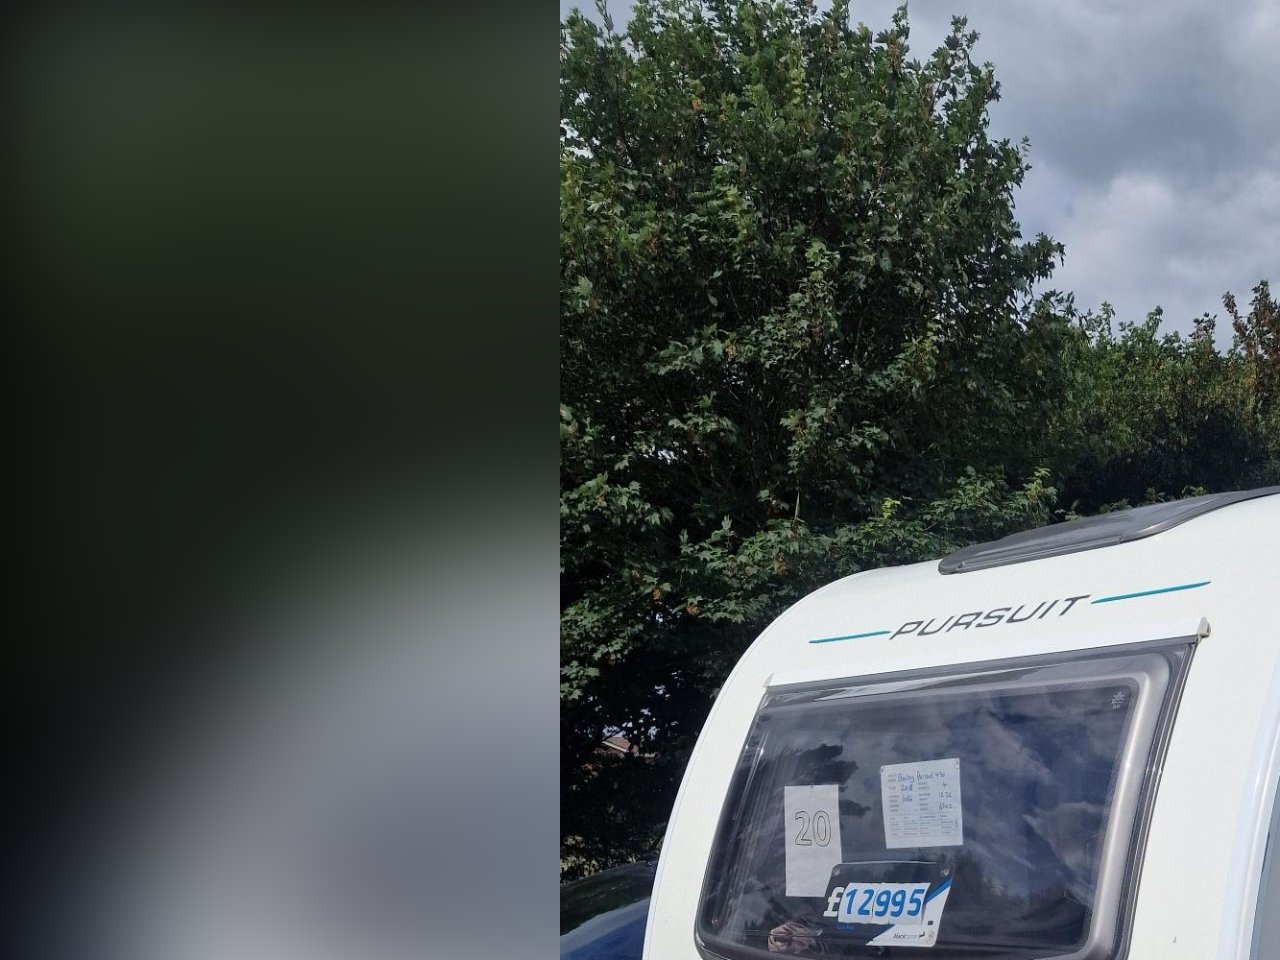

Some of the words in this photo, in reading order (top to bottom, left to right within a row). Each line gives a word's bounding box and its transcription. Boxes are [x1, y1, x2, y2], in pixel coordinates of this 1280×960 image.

[889, 594, 1091, 640] PURSUIT
[795, 810, 832, 848] 20
[823, 886, 926, 918] £12995
